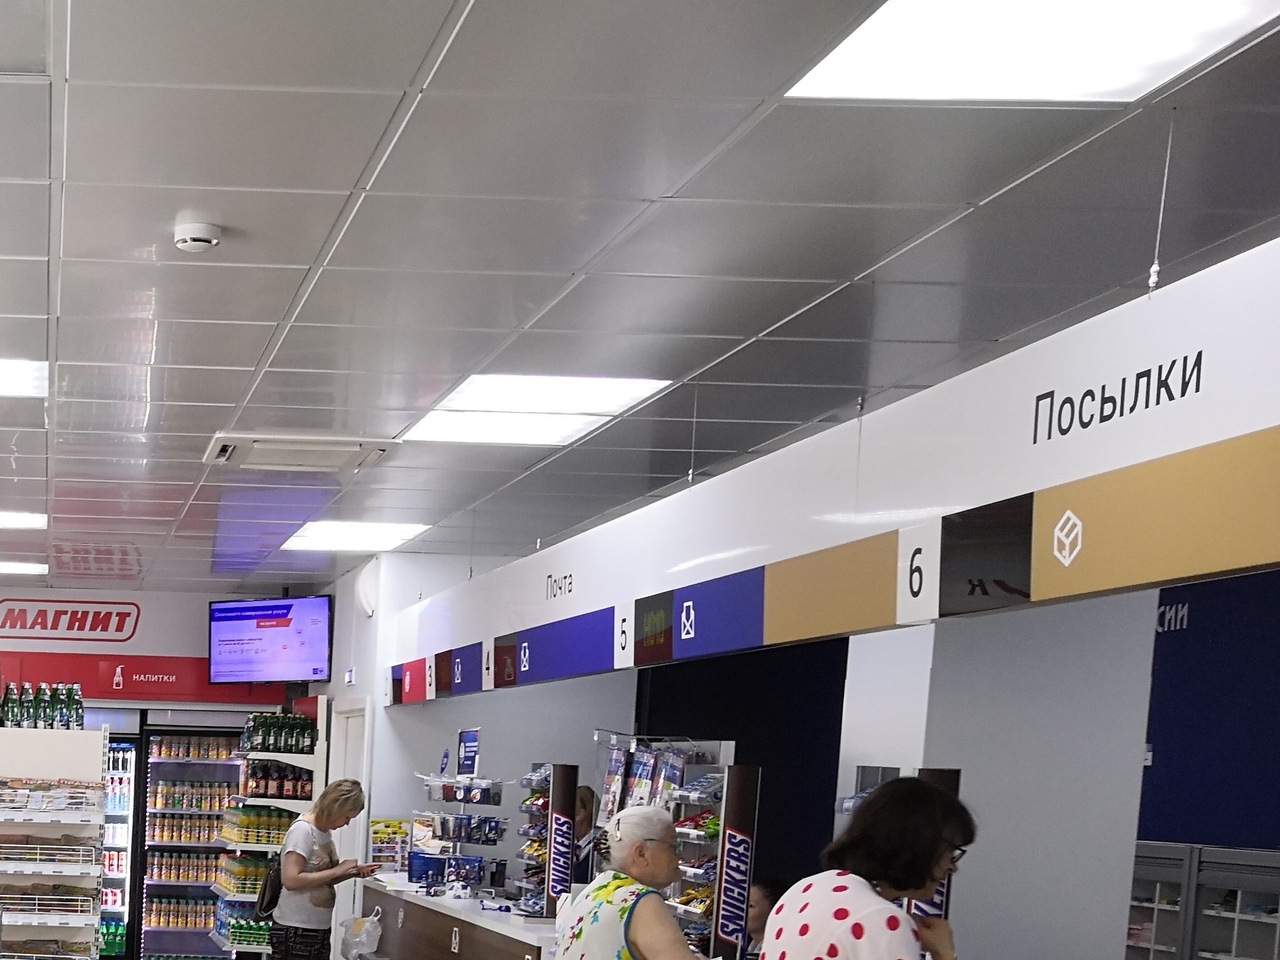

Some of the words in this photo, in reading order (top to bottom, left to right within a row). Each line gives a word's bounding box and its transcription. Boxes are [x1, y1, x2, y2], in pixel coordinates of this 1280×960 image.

[1032, 349, 1204, 445] Посылки
[546, 572, 574, 600] Почта
[908, 547, 924, 598] 6
[0, 608, 132, 633] МАГНИТ
[1156, 603, 1189, 632] СИИ
[620, 618, 627, 651] 5
[132, 673, 177, 683] НАПИТКИ
[485, 651, 490, 676] 4
[550, 815, 573, 897] SNICKERS
[720, 832, 751, 943] SNICKERS
